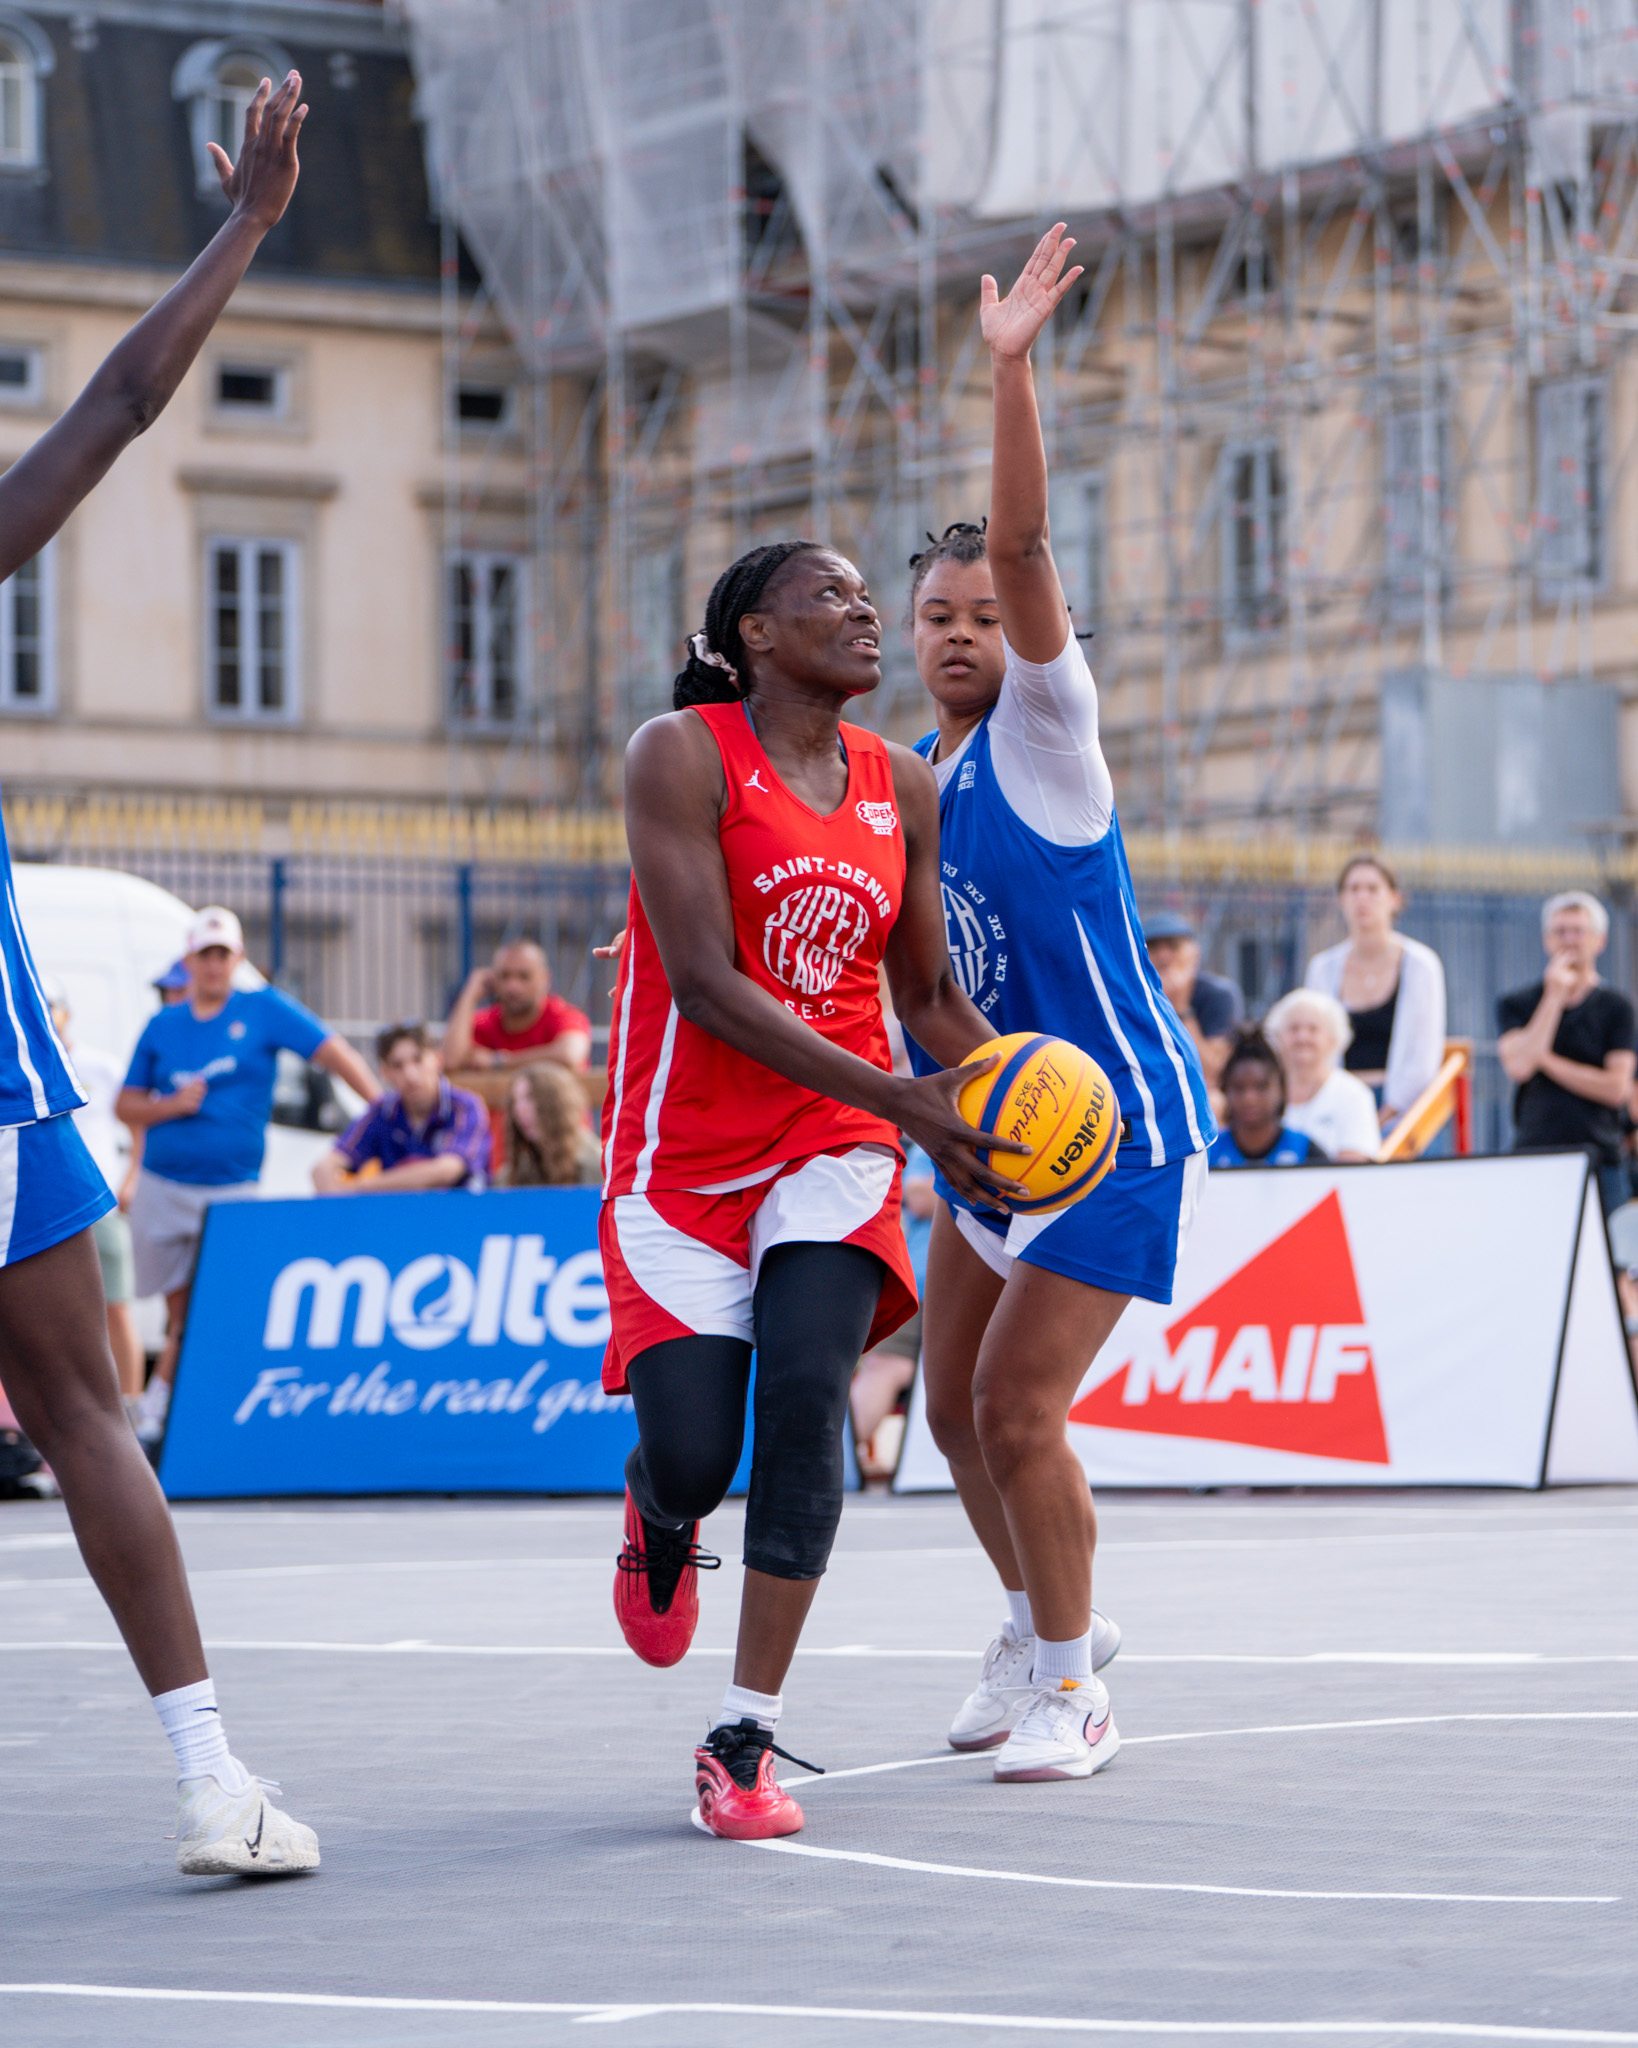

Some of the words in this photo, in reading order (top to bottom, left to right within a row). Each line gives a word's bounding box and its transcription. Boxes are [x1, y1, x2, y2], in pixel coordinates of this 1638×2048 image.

[753, 856, 891, 919] SAINT-DENIS
[963, 880, 986, 905] 3X3
[765, 885, 871, 958] SUPER
[987, 914, 1007, 941] 3X3
[763, 926, 856, 996] LEAGUE
[994, 953, 1008, 982] 3X3
[980, 988, 1000, 1013] 3X3
[1009, 1054, 1067, 1143] Libertria
[1016, 1080, 1034, 1107] 3X3
[1049, 1081, 1106, 1176] molten
[262, 1234, 612, 1351] molte
[233, 1365, 330, 1425] For
[327, 1360, 418, 1416] the
[419, 1359, 549, 1415] real
[1121, 1324, 1370, 1406] MAIF
